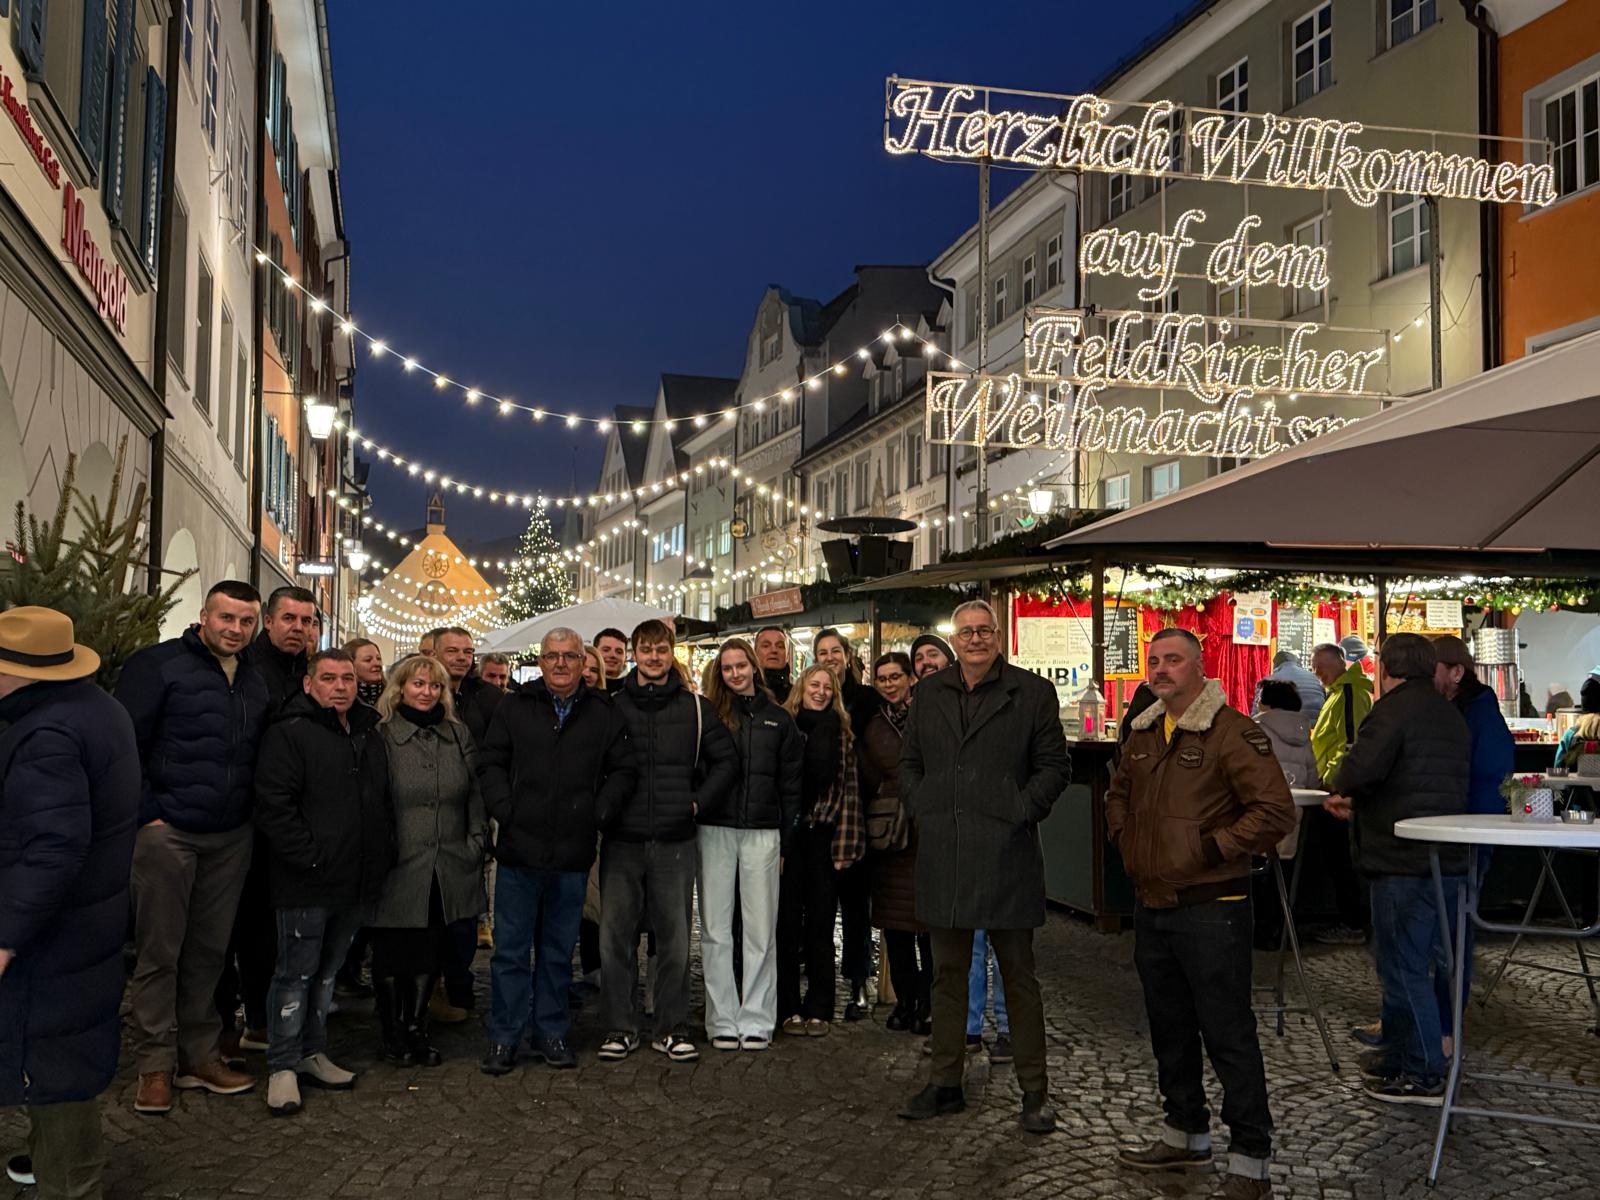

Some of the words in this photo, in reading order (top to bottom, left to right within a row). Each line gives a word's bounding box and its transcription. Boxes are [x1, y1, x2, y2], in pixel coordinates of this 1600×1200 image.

[885, 84, 1175, 174] Herzlich
[1191, 113, 1557, 207] Willkommen
[61, 181, 127, 337] Mangold
[1080, 208, 1206, 301] auf
[1207, 214, 1330, 292] dem
[1025, 310, 1384, 404] Feldkircher
